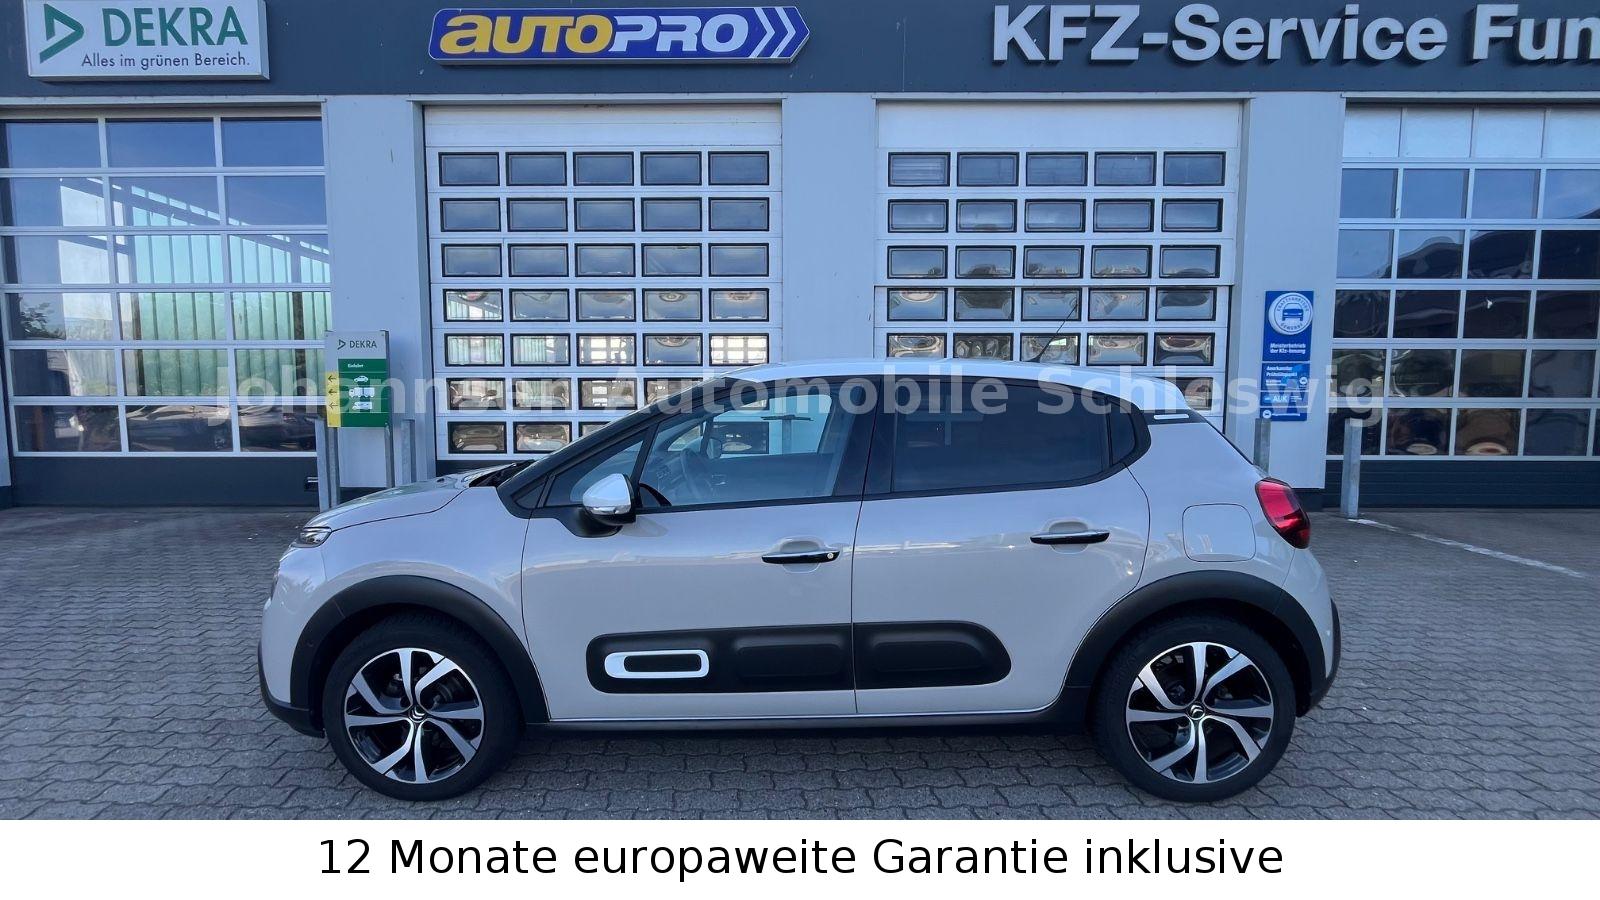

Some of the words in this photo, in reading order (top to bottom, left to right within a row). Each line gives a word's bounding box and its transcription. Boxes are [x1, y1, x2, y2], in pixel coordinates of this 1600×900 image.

[102, 5, 249, 47] DEKRA
[993, 3, 1448, 61] KFZ-Service
[1473, 3, 1600, 60] Fun
[81, 52, 115, 67] Alles
[120, 54, 136, 67] im
[140, 54, 189, 71] grünen
[194, 51, 251, 67] Bereich.
[349, 340, 377, 349] DEKRA
